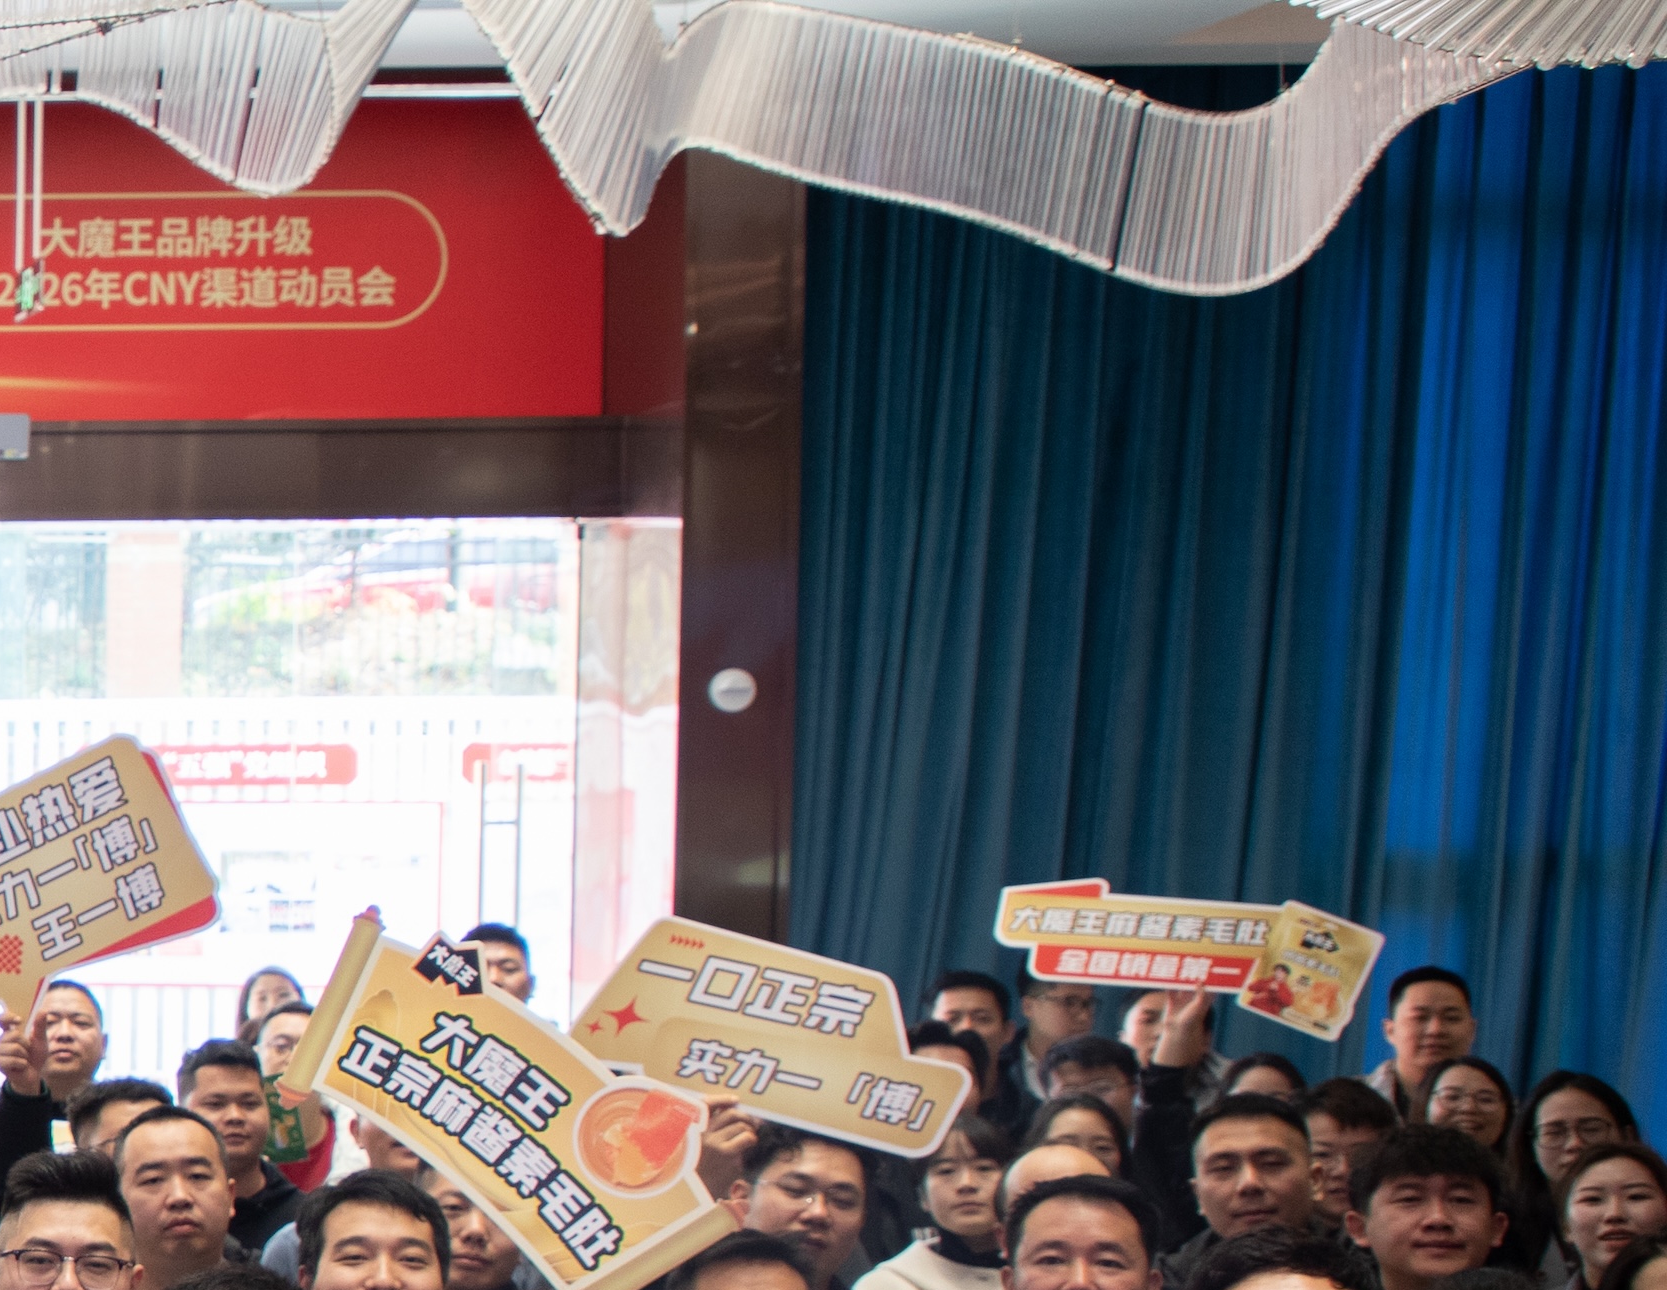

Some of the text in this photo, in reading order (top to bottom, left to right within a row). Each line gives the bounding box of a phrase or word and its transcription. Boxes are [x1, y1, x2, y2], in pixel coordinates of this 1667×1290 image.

[39, 217, 312, 258] 大魔王品牌升级
[32, 862, 165, 961] 王一博
[1009, 906, 1269, 947] 大魔王麻酱素毛肚
[426, 942, 480, 989] 大魔王
[637, 955, 875, 1037] 一口正宗
[1056, 948, 1243, 980] 全国销量第一
[418, 1010, 570, 1133] 大魔王
[337, 1024, 625, 1272] 正宗麻酱素毛肚
